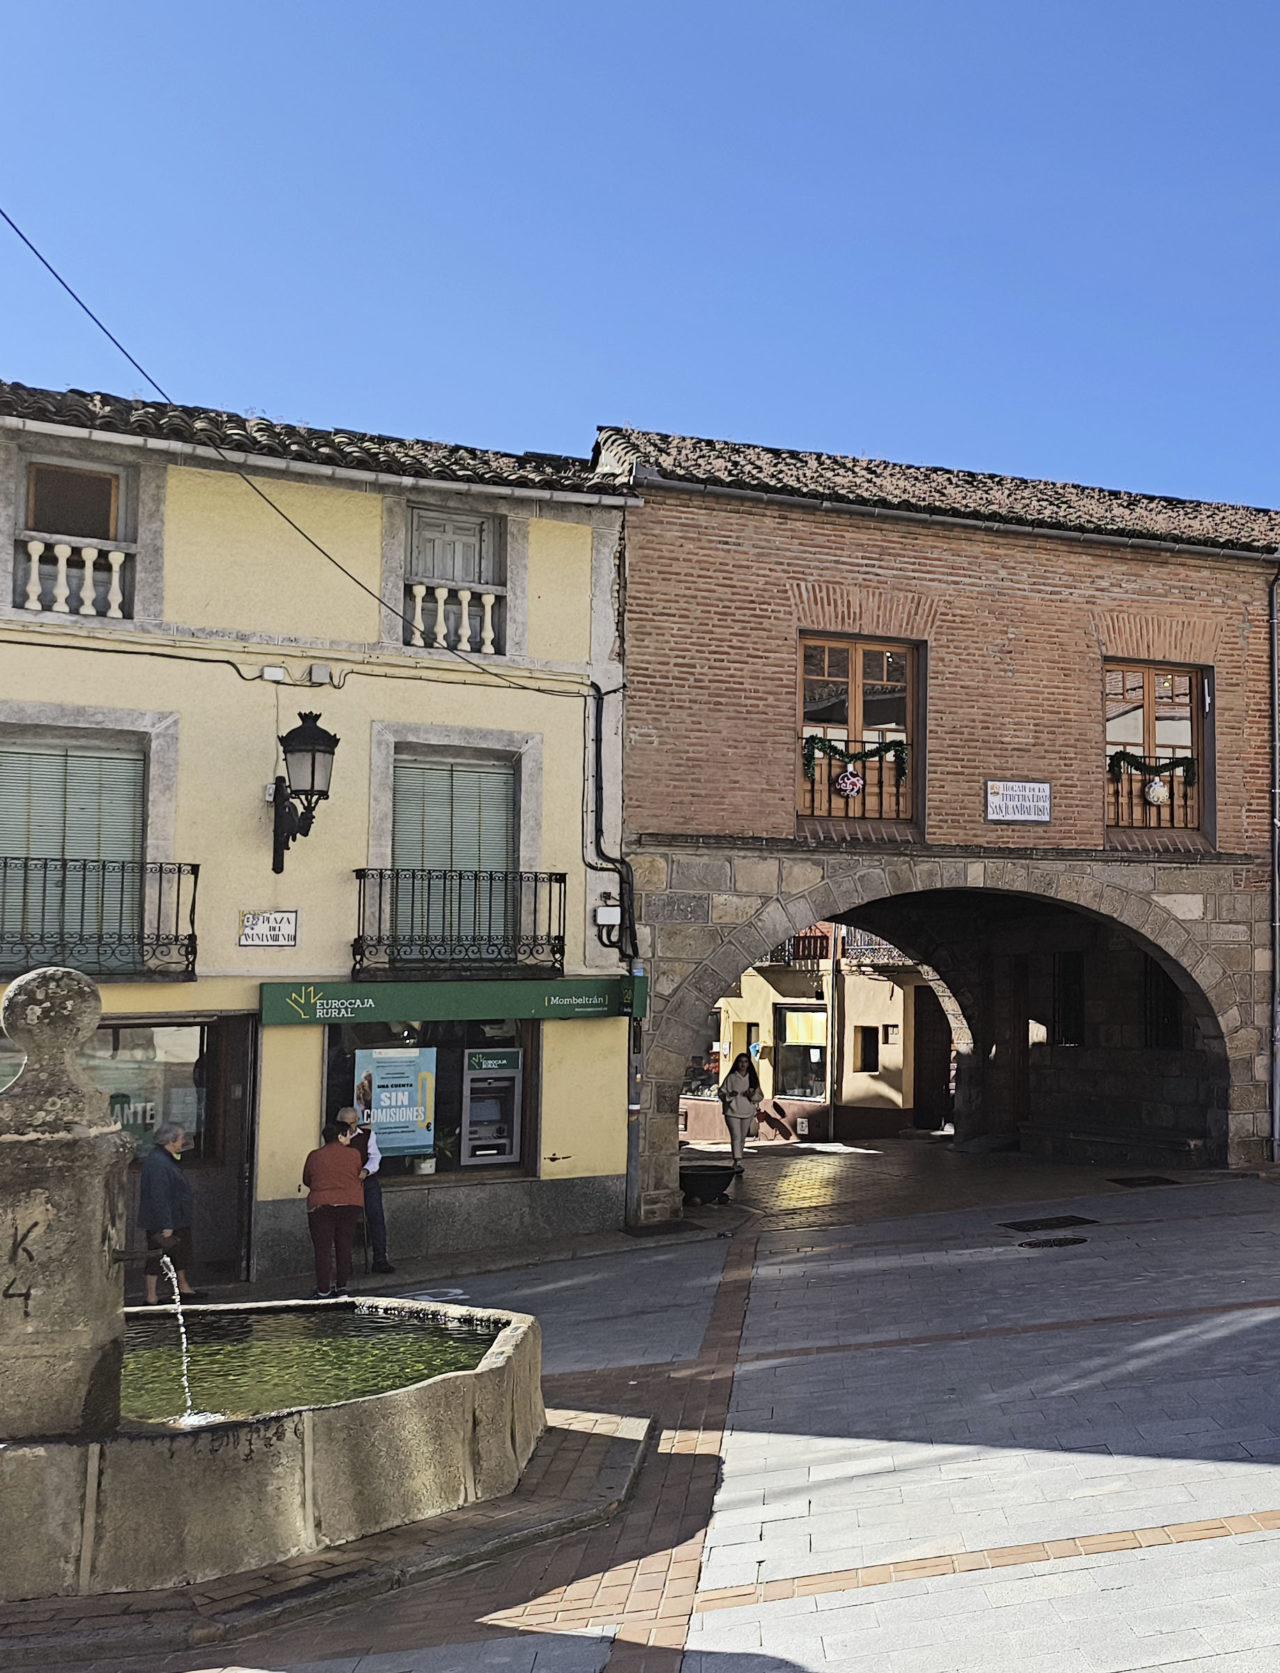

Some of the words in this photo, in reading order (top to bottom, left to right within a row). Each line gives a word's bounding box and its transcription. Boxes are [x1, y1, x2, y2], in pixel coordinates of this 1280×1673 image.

[1003, 783, 1027, 793] HOGAR
[1001, 793, 1031, 803] TERCERA
[989, 801, 1003, 815] SAN
[316, 999, 375, 1009] EUROCAJA
[316, 1008, 355, 1018] RURAL
[380, 1091, 409, 1107] SIN
[364, 1107, 425, 1123] COMISIONES
